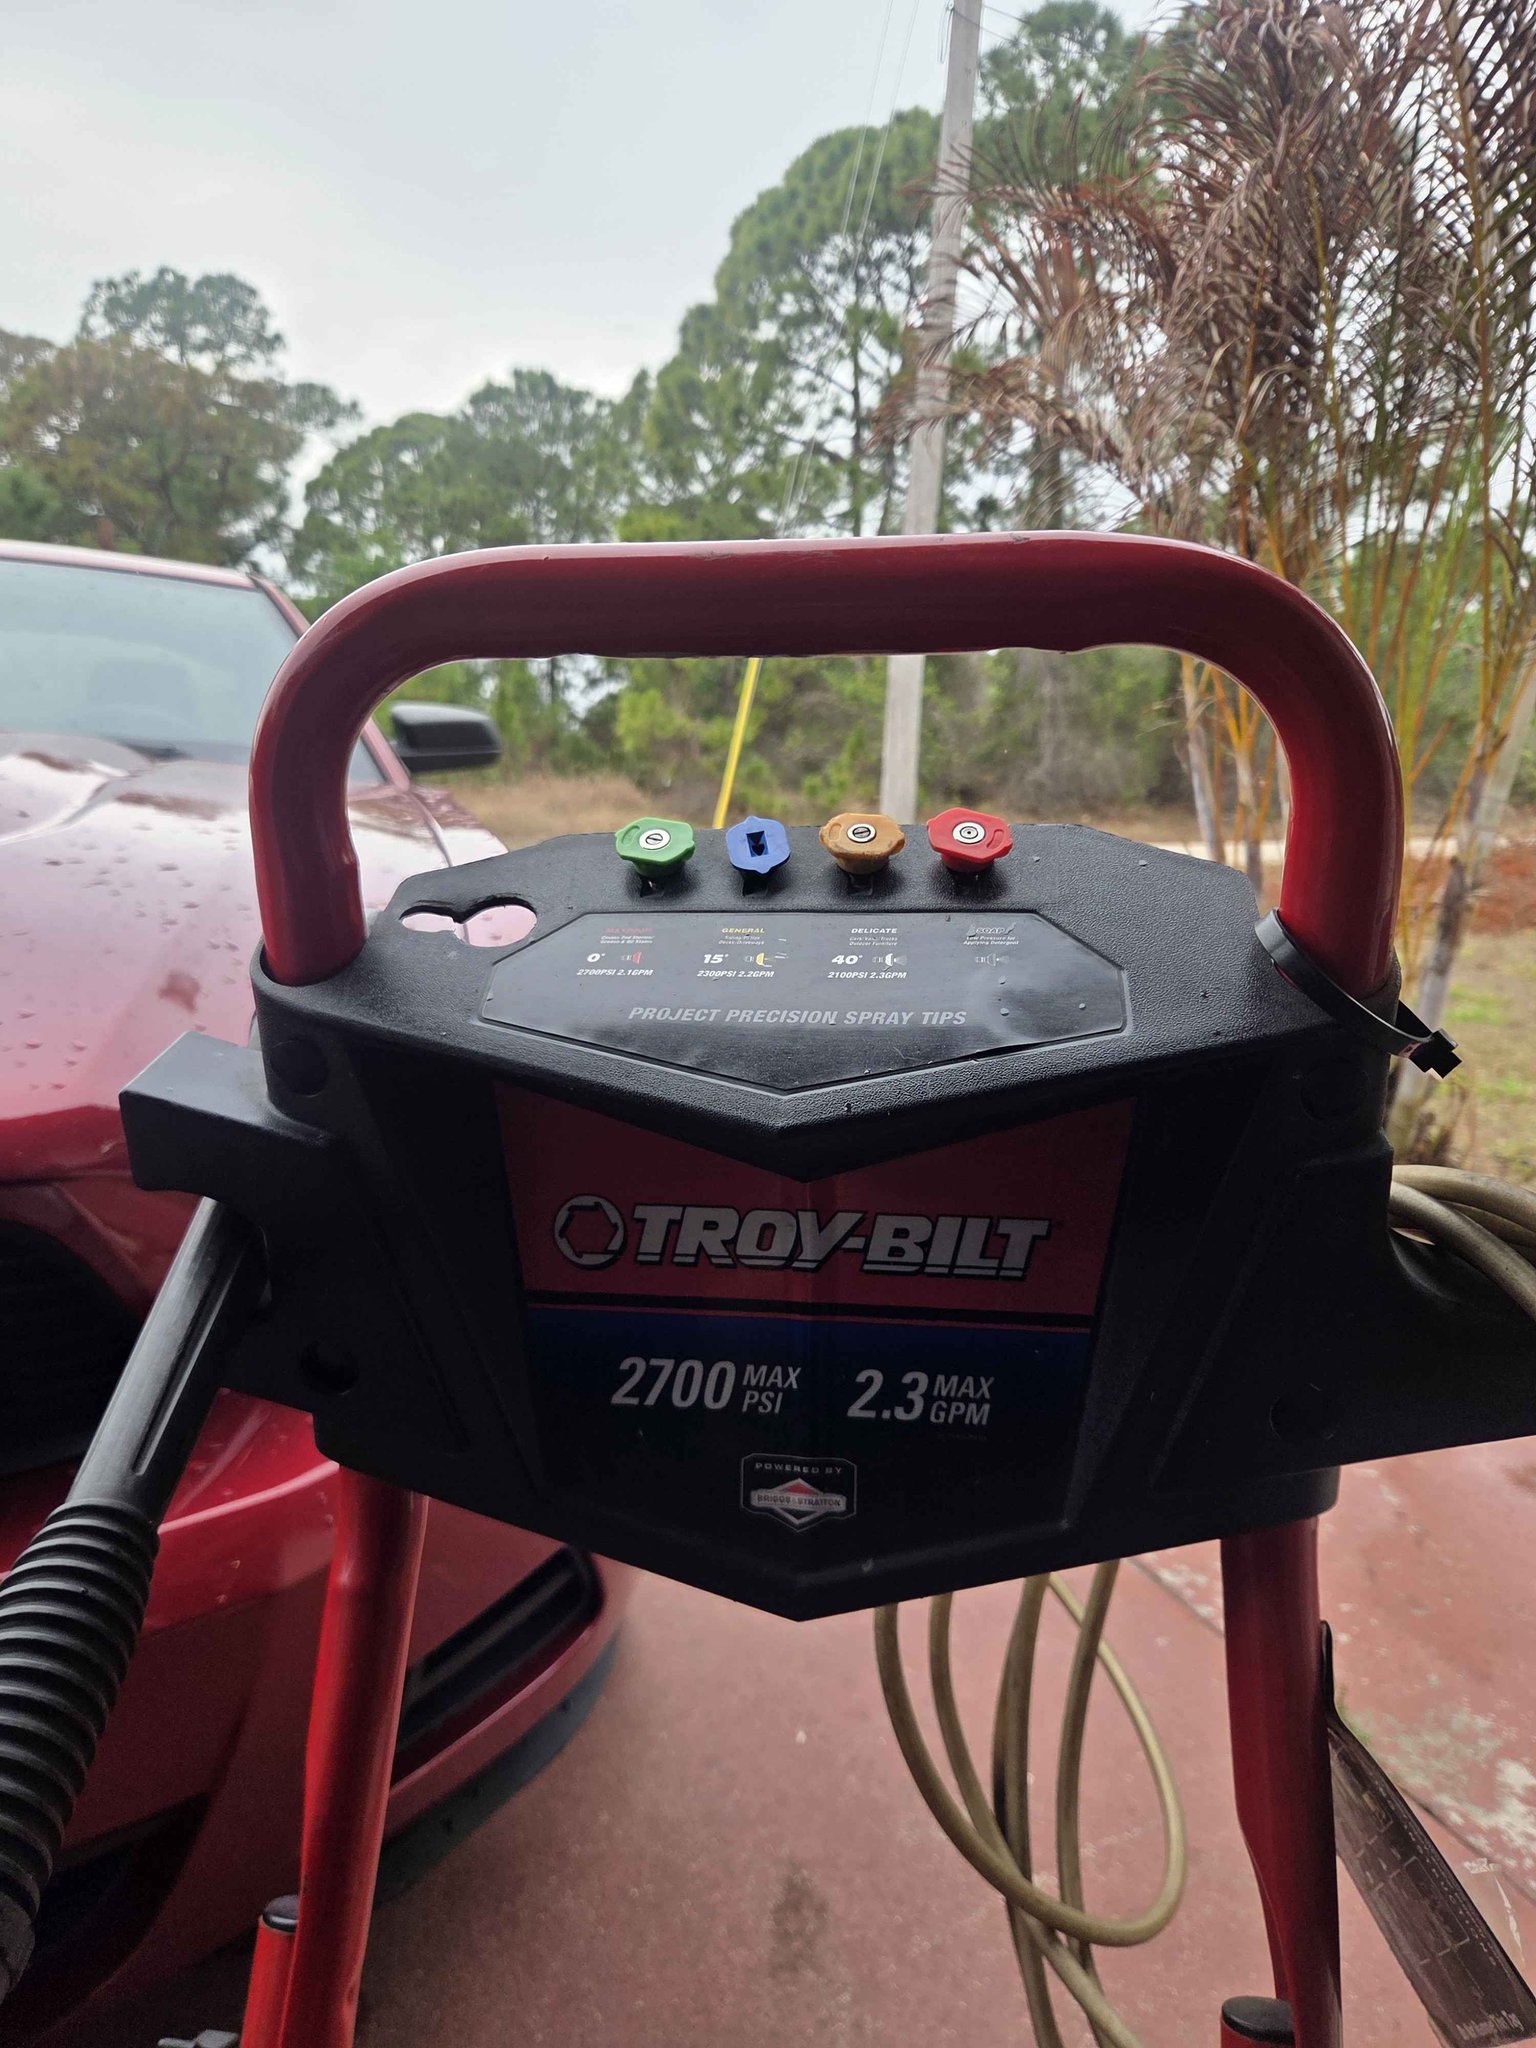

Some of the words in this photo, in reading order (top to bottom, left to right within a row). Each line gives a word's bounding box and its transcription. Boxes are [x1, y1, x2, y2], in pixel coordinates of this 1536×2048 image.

[628, 1007, 721, 1022] PROJECT
[724, 1009, 838, 1024] PRECISION
[843, 1011, 914, 1025] SPRAY
[921, 1011, 967, 1026] TIPS
[631, 1203, 1052, 1281] TROY-BILT
[610, 1356, 737, 1410] 2700
[742, 1364, 802, 1389] MAX
[846, 1368, 929, 1421] 2.3
[932, 1374, 996, 1399] MAX
[742, 1390, 784, 1414] PSI
[929, 1401, 991, 1426] GPM
[755, 1462, 820, 1474] POWERED
